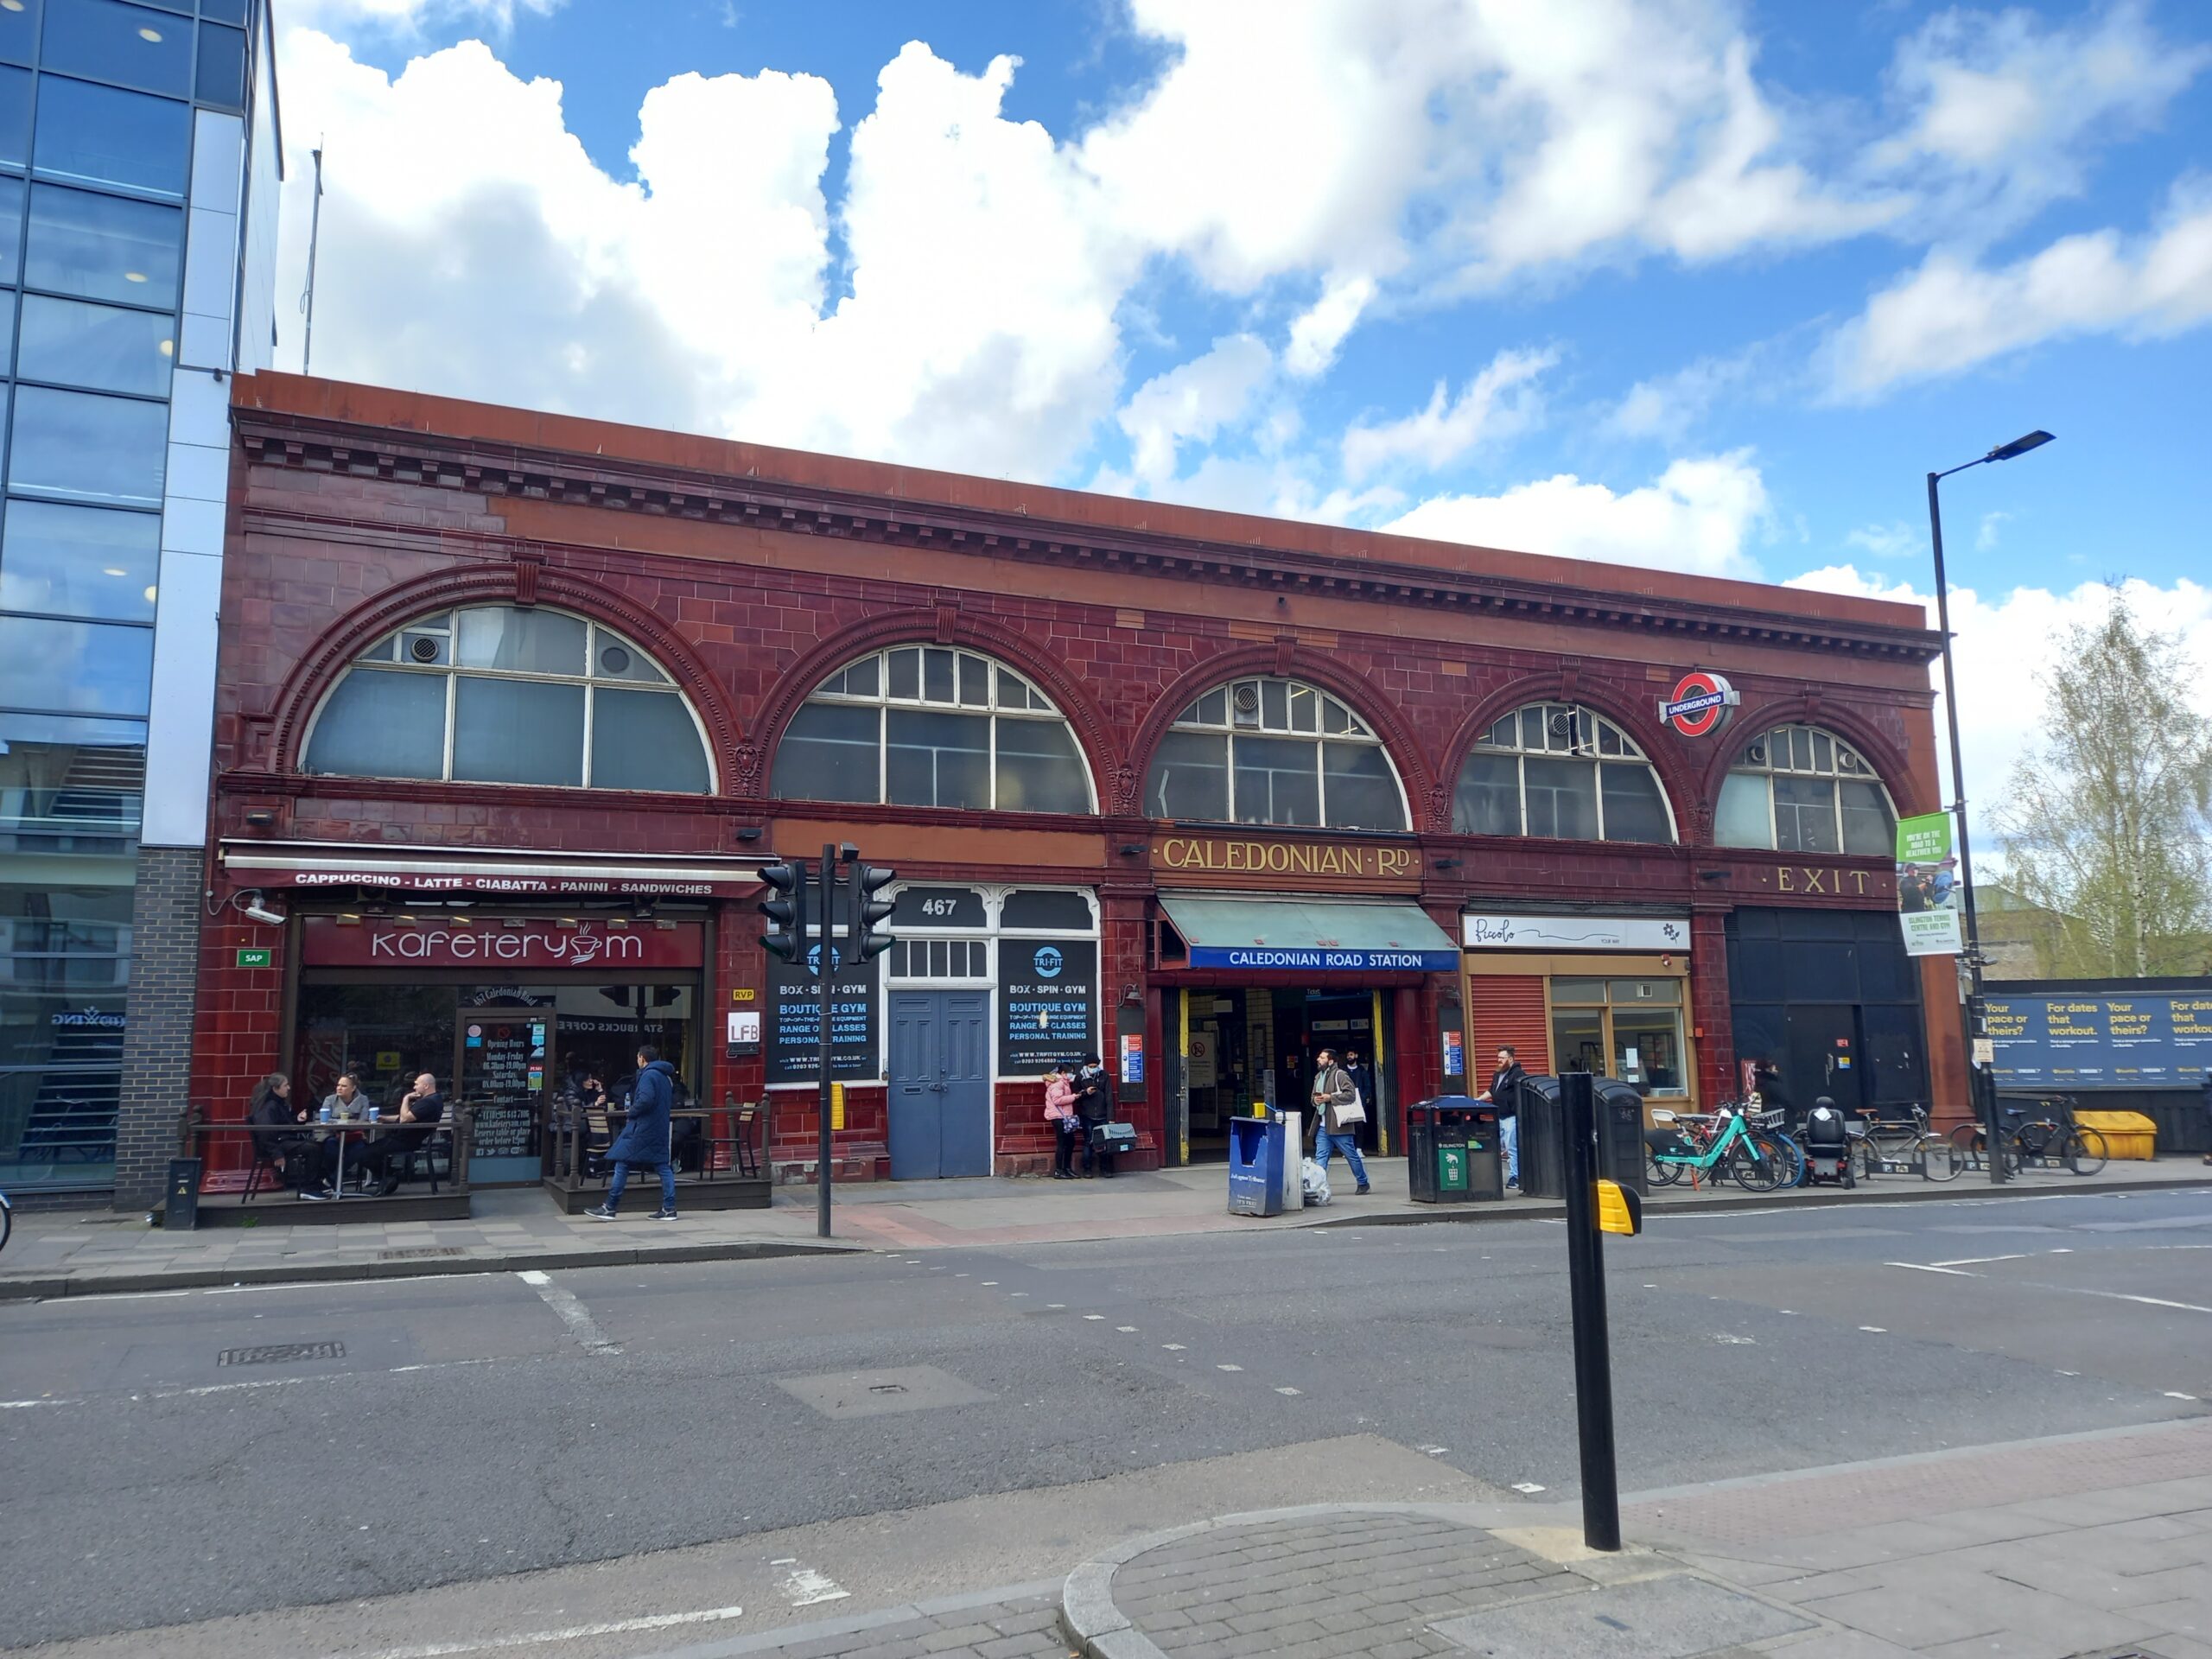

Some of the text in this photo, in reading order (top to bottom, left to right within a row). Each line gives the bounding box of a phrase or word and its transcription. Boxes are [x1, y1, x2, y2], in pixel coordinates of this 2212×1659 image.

[1669, 695, 1721, 715] UNDERGROUND
[1163, 838, 1363, 874] CALEDONIAN
[295, 874, 713, 894] CAPPUCCINO LATTE CIABATTA PANINI SANDWICHES
[1777, 867, 1871, 894] EXIT
[922, 899, 957, 915] 467
[1229, 951, 1422, 968] CALEDONIAN ROAD STATION
[779, 986, 804, 995] BOX
[842, 985, 867, 994] GYM
[1009, 985, 1086, 994] BOX SPIN GYM
[485, 987, 520, 1000] Caledonian
[520, 990, 538, 1007] Road
[841, 1003, 867, 1013] GYM
[1009, 1002, 1086, 1012] BOUTIQUE GYM
[1985, 1003, 2010, 1013] Your
[2046, 1002, 2098, 1013] For dates
[2106, 1002, 2133, 1012] Your
[2171, 1001, 2190, 1011] For
[1987, 1015, 2013, 1026] pace
[2047, 1014, 2070, 1024] that
[2109, 1014, 2152, 1024] pace or
[2171, 1013, 2195, 1022] that
[731, 1025, 759, 1040] LFB
[779, 1025, 810, 1033] RANGE
[832, 1024, 867, 1033] LASSES
[1987, 1026, 2024, 1035] theirs?
[2049, 1026, 2098, 1035] workout.
[2110, 1025, 2147, 1035] theirs?
[487, 1039, 508, 1050] Opening
[509, 1039, 524, 1048] Hours
[779, 1036, 821, 1045] PERSONA
[493, 1095, 513, 1103] Contact
